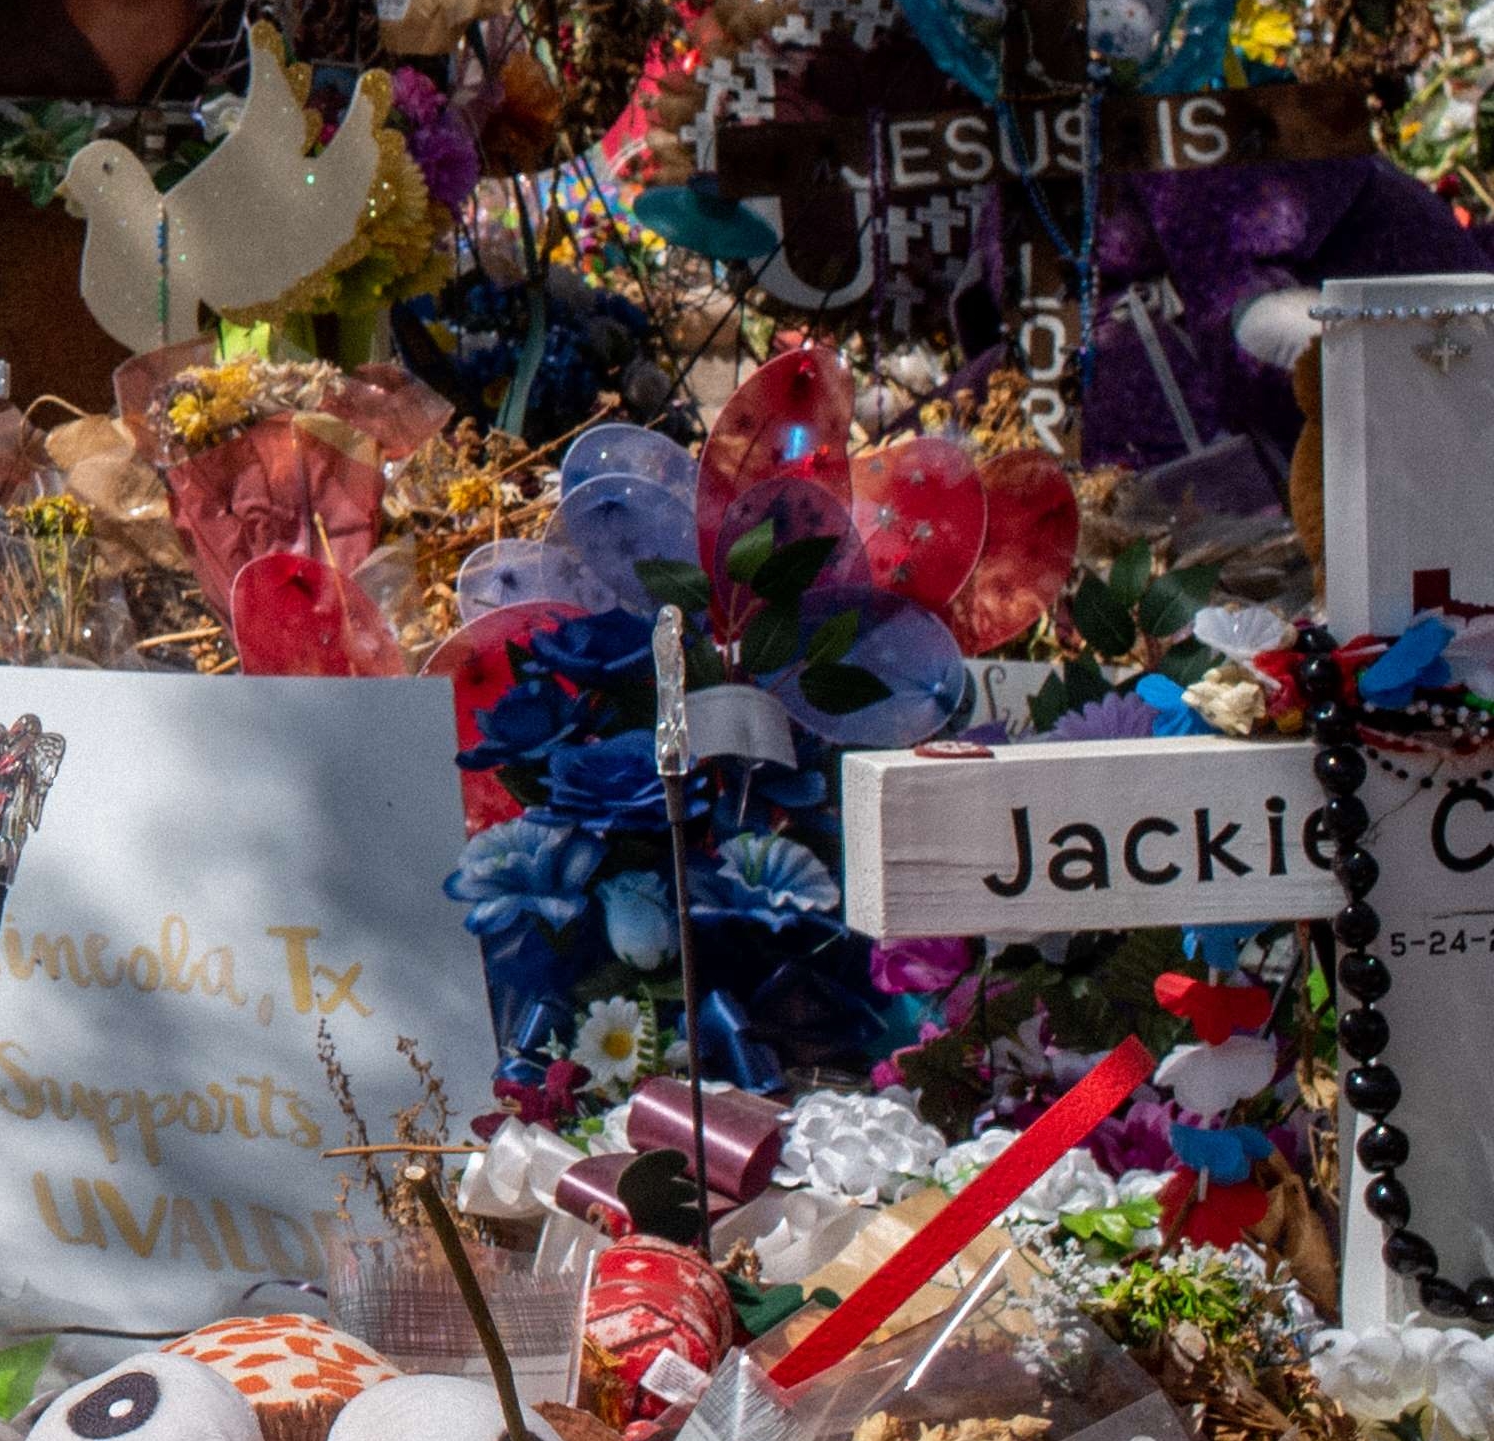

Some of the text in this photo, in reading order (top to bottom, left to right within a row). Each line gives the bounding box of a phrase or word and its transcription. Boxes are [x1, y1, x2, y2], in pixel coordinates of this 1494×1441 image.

[1156, 97, 1230, 170] IS
[983, 796, 1336, 898] Jackie
[1390, 929, 1494, 957] 5-24-
